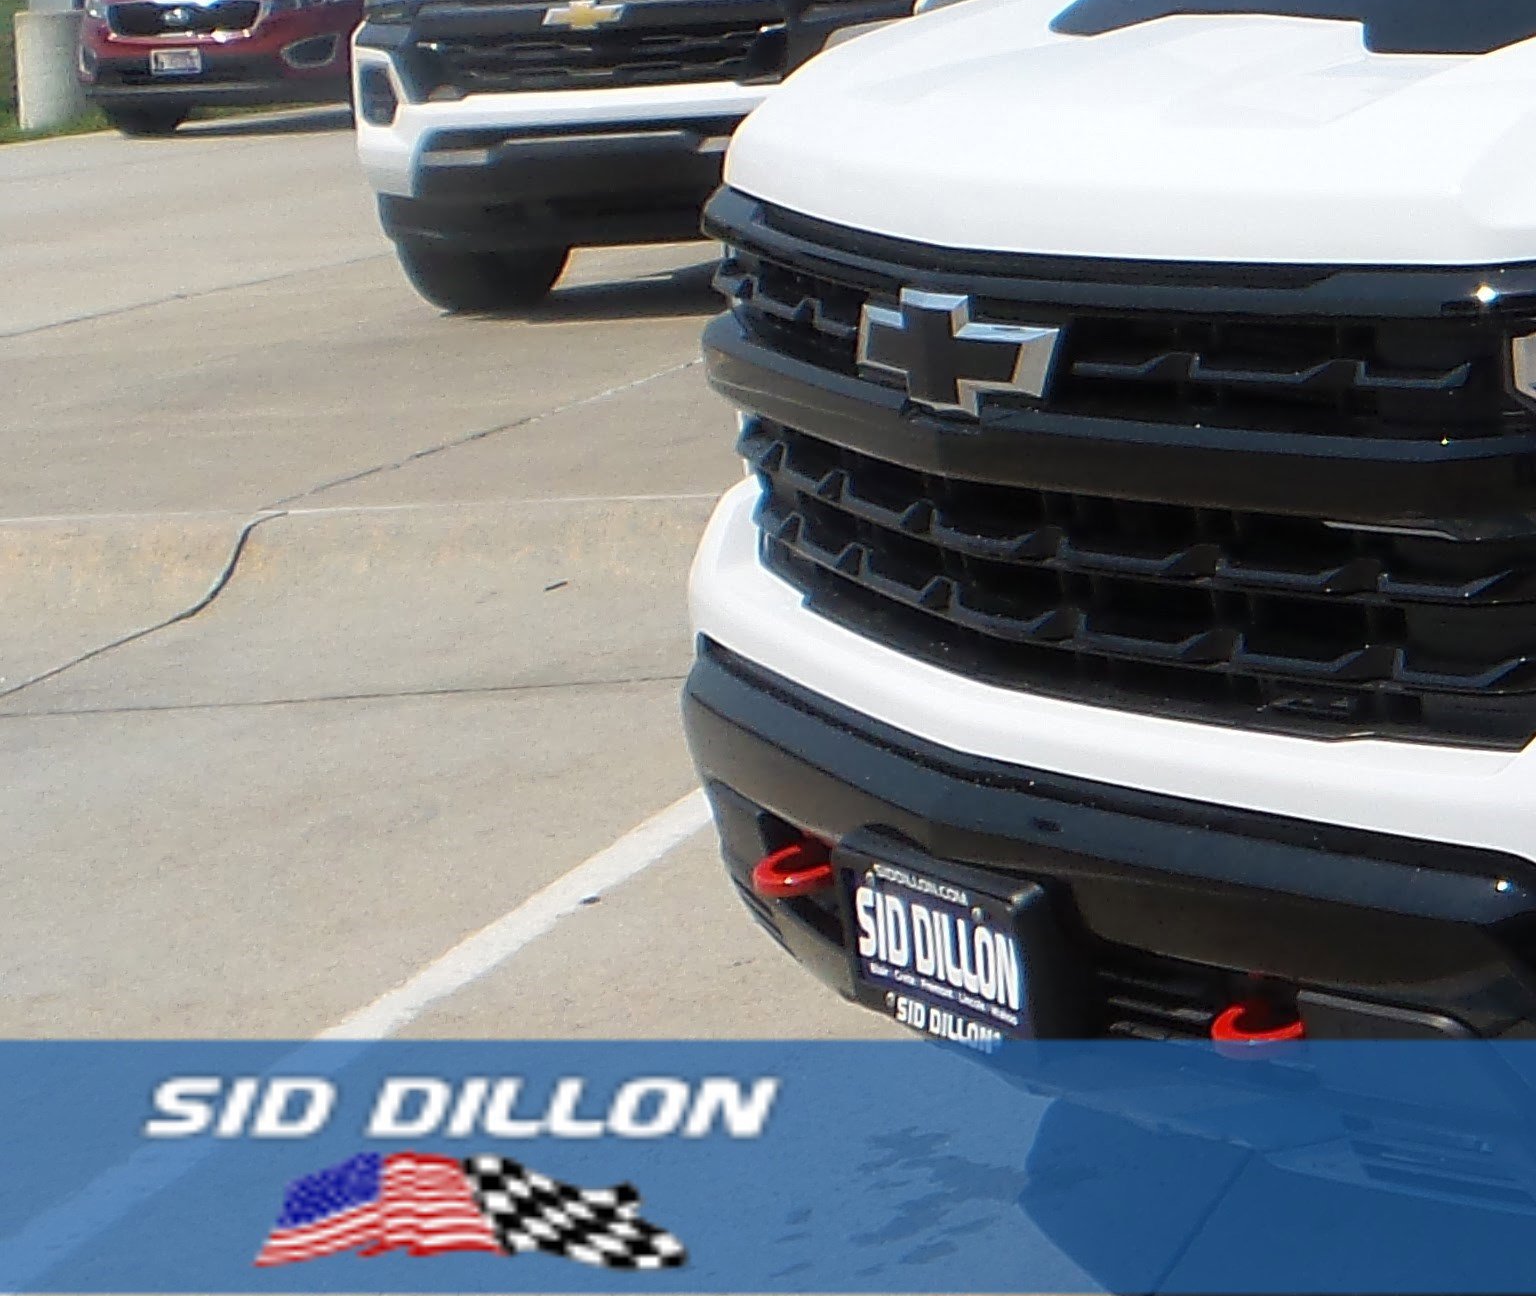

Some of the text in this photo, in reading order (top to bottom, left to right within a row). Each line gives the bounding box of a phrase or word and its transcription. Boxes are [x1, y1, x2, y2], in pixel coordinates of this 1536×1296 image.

[856, 886, 909, 968] SID
[911, 903, 1019, 1011] DILLON
[896, 996, 926, 1030] SID
